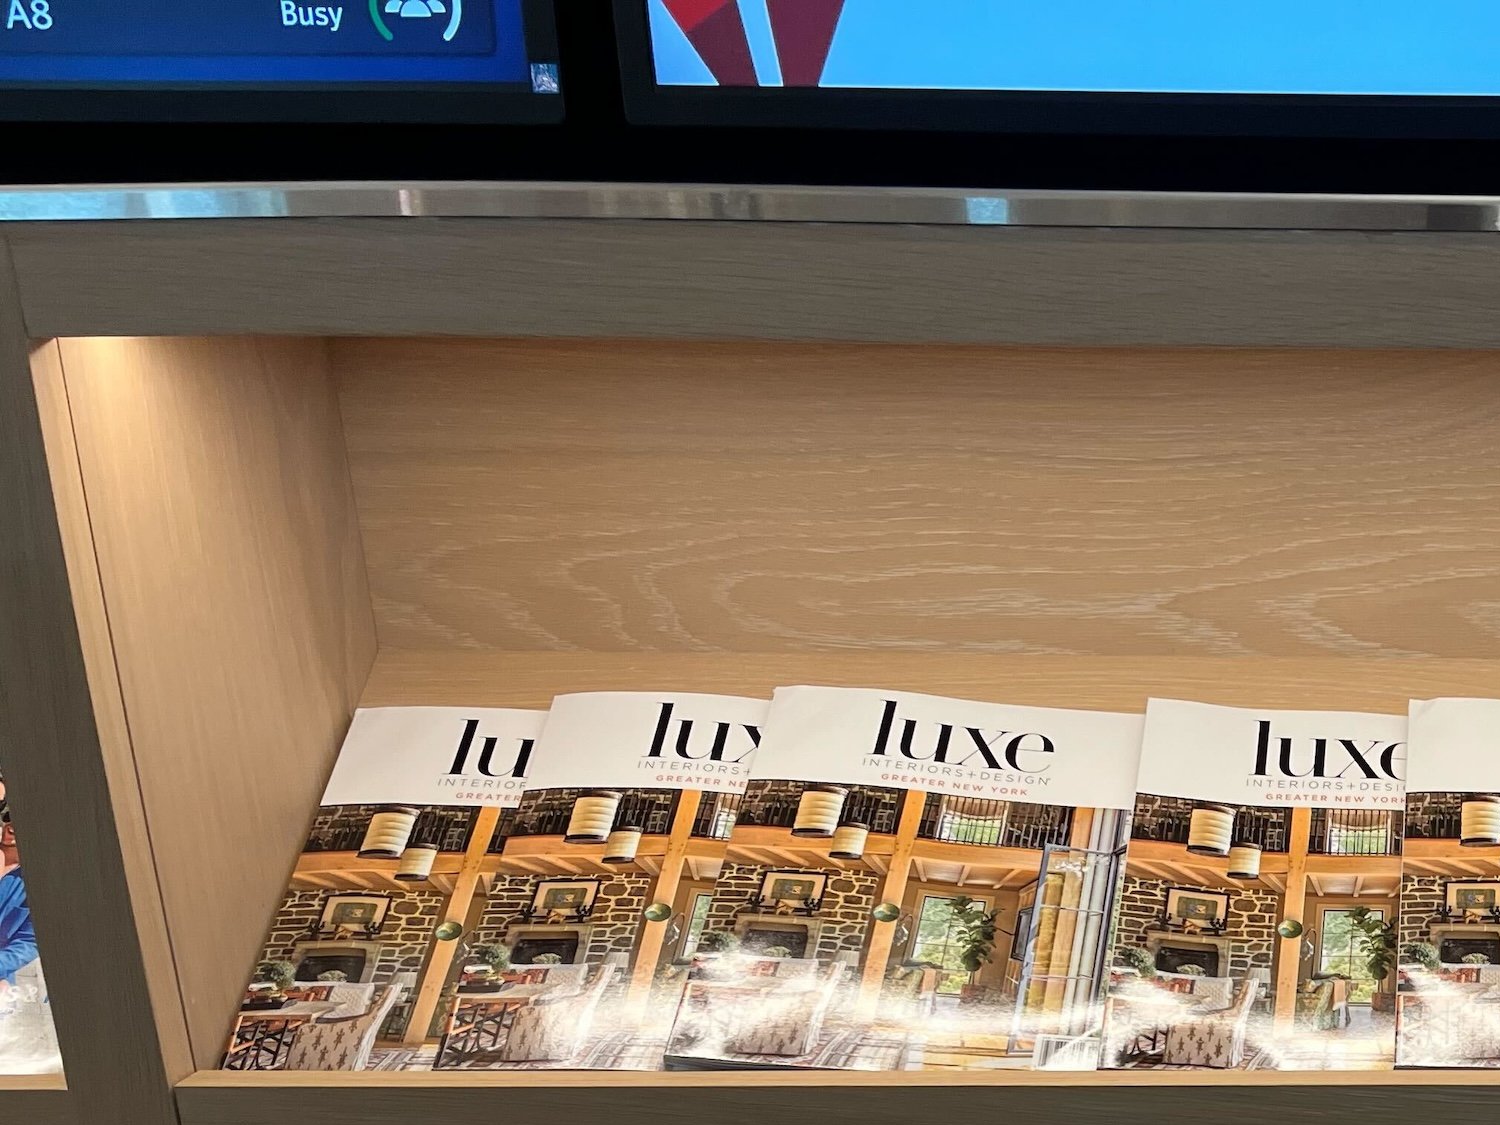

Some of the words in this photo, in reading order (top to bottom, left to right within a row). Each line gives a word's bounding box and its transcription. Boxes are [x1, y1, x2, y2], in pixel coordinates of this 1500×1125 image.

[7, 0, 53, 30] A8
[281, 0, 343, 32] Busy
[866, 699, 1055, 774] luxe
[655, 774, 721, 786] GREATER
[881, 773, 946, 788] GREATER
[952, 782, 983, 793] NEW
[991, 786, 1029, 797] YORK
[1266, 792, 1328, 803] GREATER
[1335, 794, 1364, 803] NEW
